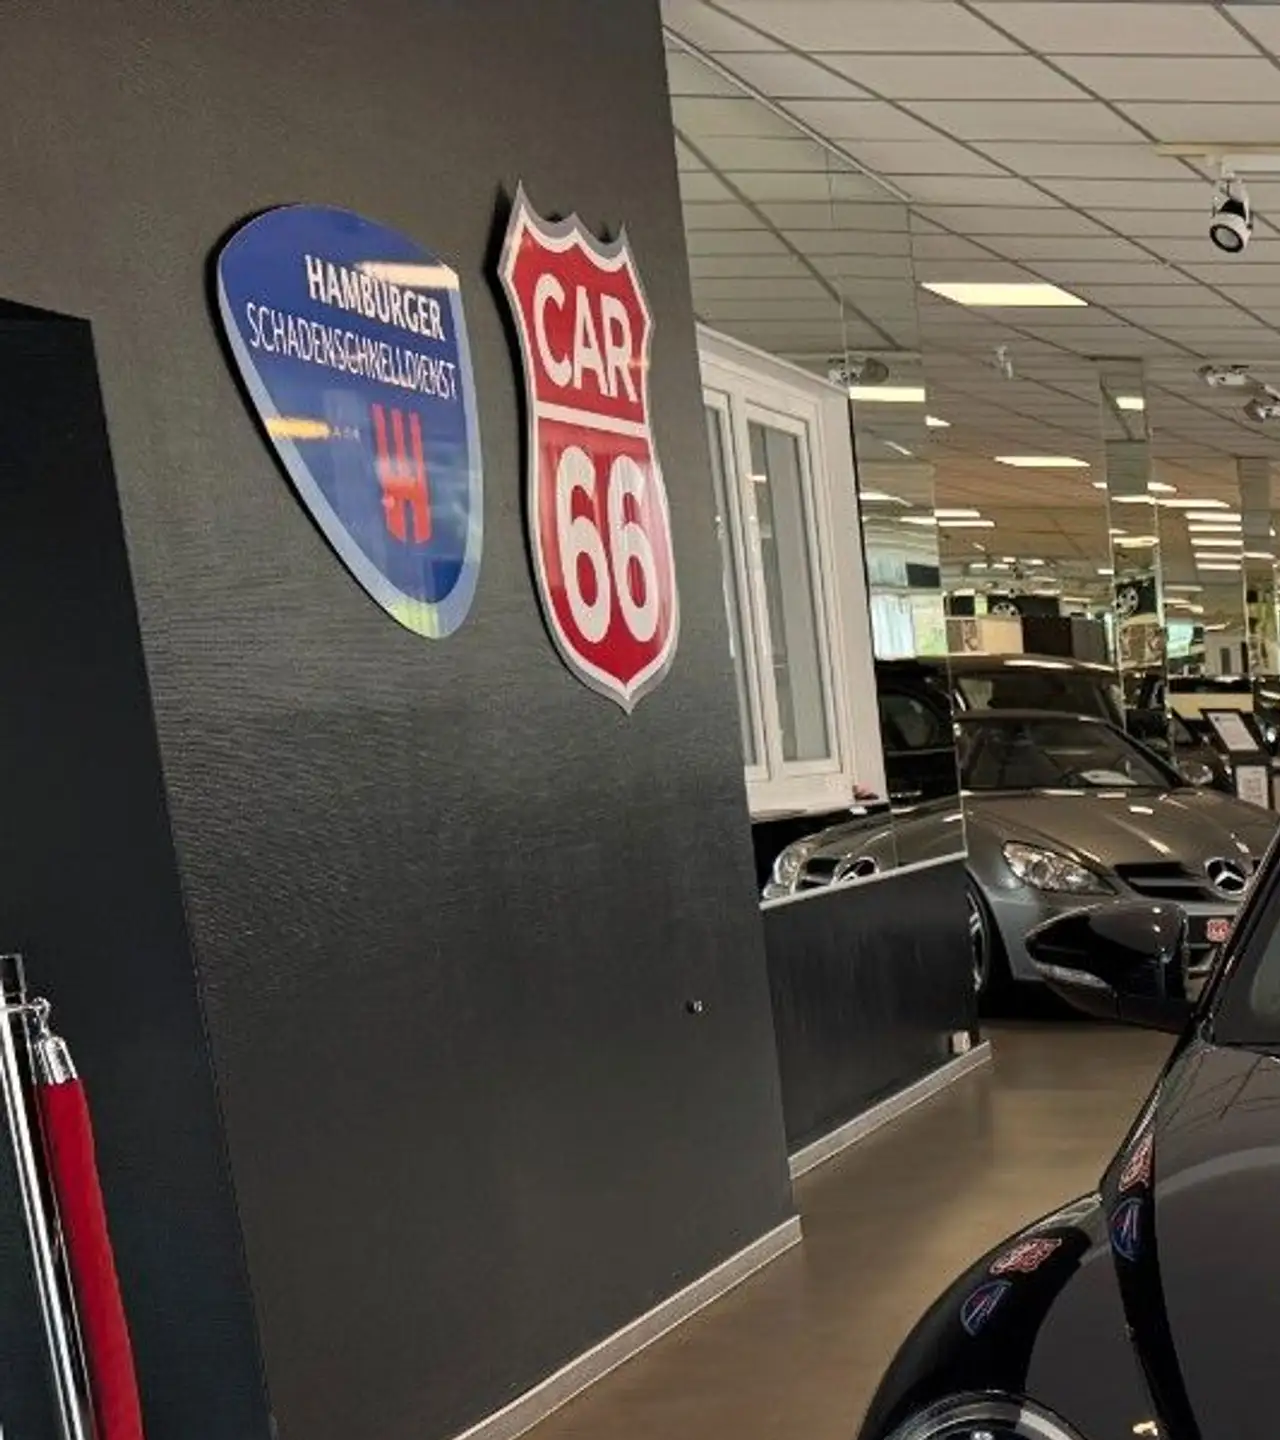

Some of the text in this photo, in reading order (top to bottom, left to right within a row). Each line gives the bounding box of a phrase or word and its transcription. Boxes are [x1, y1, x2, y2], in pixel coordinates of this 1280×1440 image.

[247, 301, 457, 400] SCHADENSCHNELLDIENST
[305, 254, 446, 342] HAMBURGER
[532, 273, 638, 402] CAR
[555, 444, 660, 644] 66
